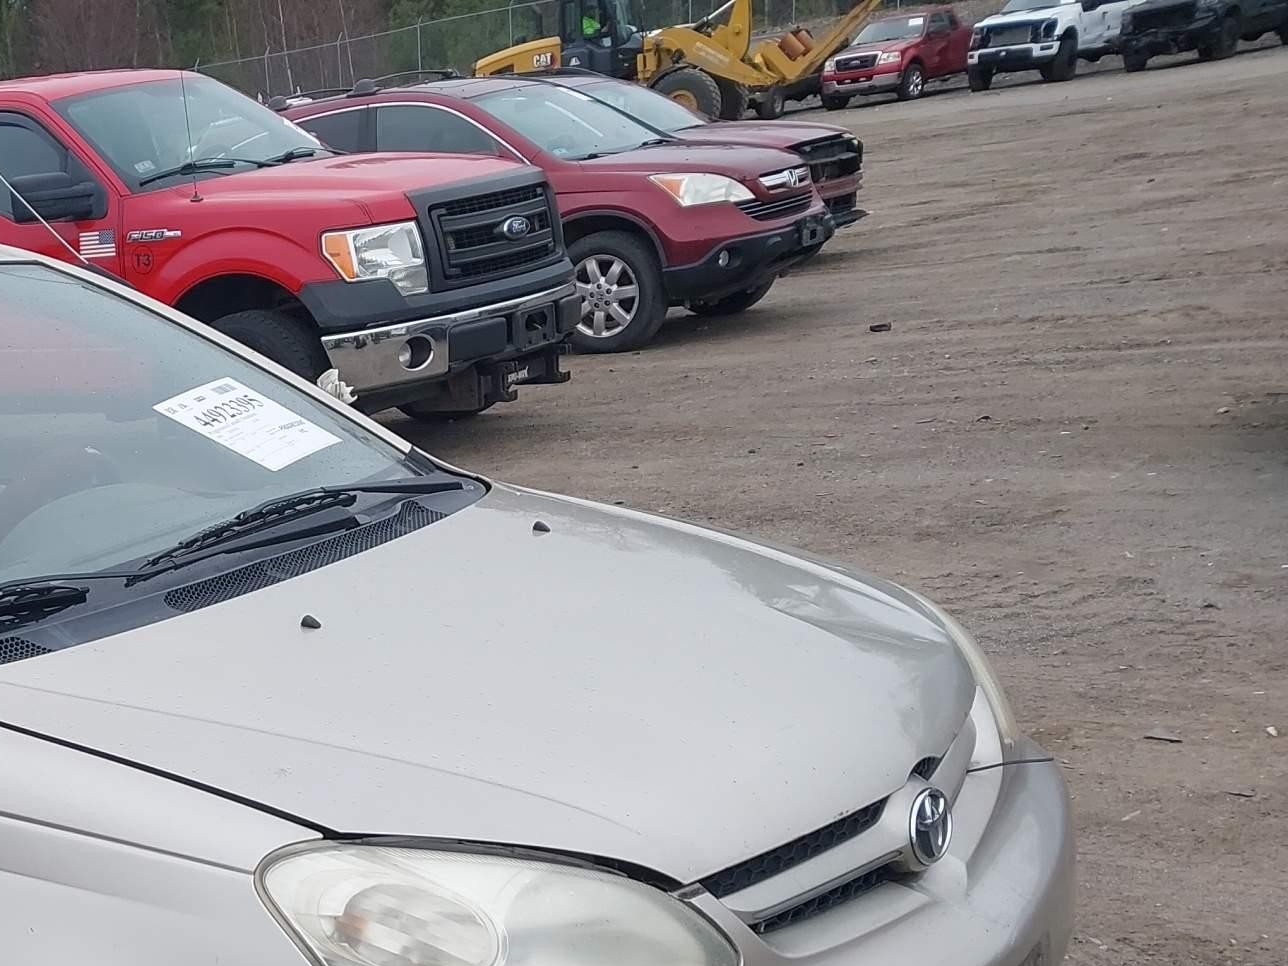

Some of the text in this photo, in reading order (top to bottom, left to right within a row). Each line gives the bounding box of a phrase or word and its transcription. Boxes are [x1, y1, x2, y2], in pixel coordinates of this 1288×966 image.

[533, 52, 552, 68] CAT
[134, 252, 151, 267] T3
[193, 394, 265, 428] 44923395
